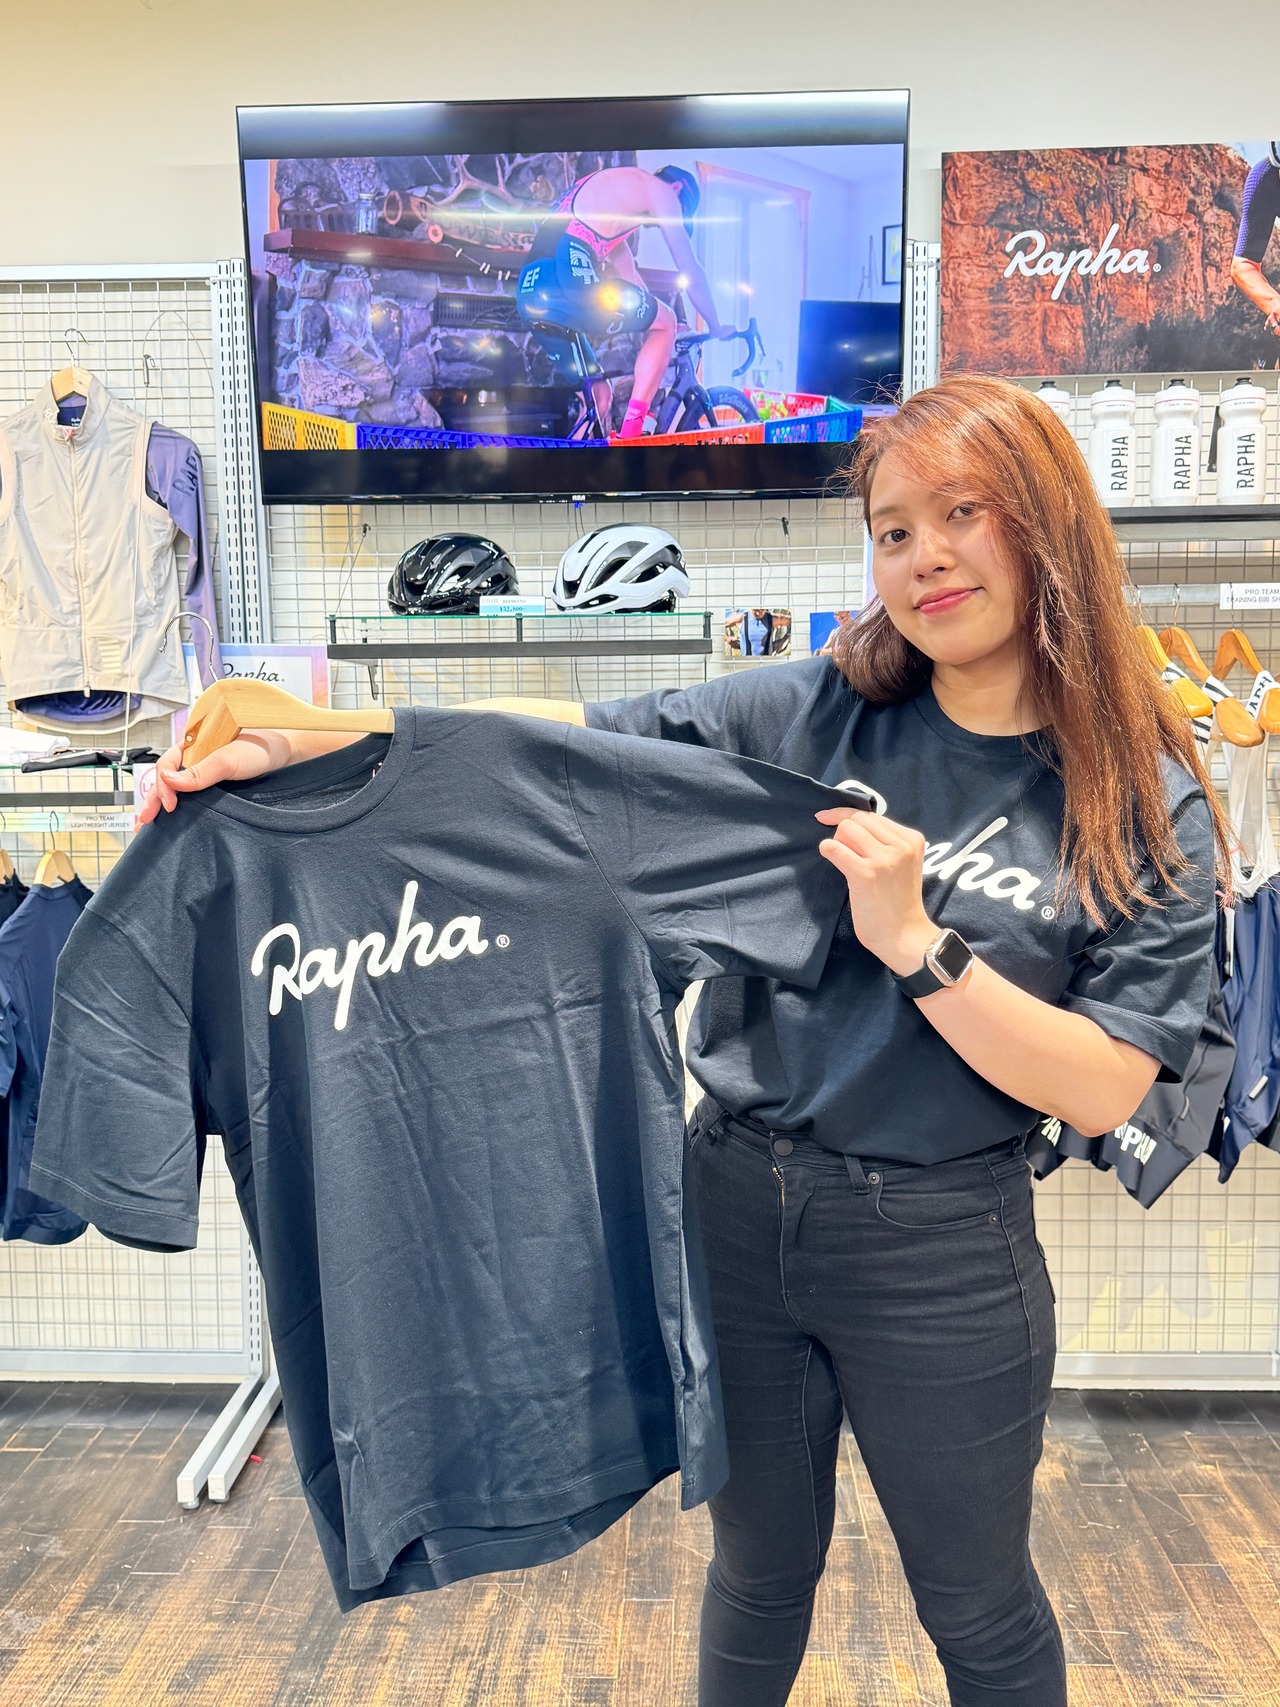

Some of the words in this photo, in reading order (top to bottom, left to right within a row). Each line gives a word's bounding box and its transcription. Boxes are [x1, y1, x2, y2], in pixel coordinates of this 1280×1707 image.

[521, 267, 541, 288] EF
[1004, 223, 1149, 301] Rapha
[1111, 435, 1129, 491] RAPHA
[1173, 434, 1192, 490] RAPHA
[1236, 432, 1256, 489] RAPHA
[251, 880, 489, 1031] Rapha
